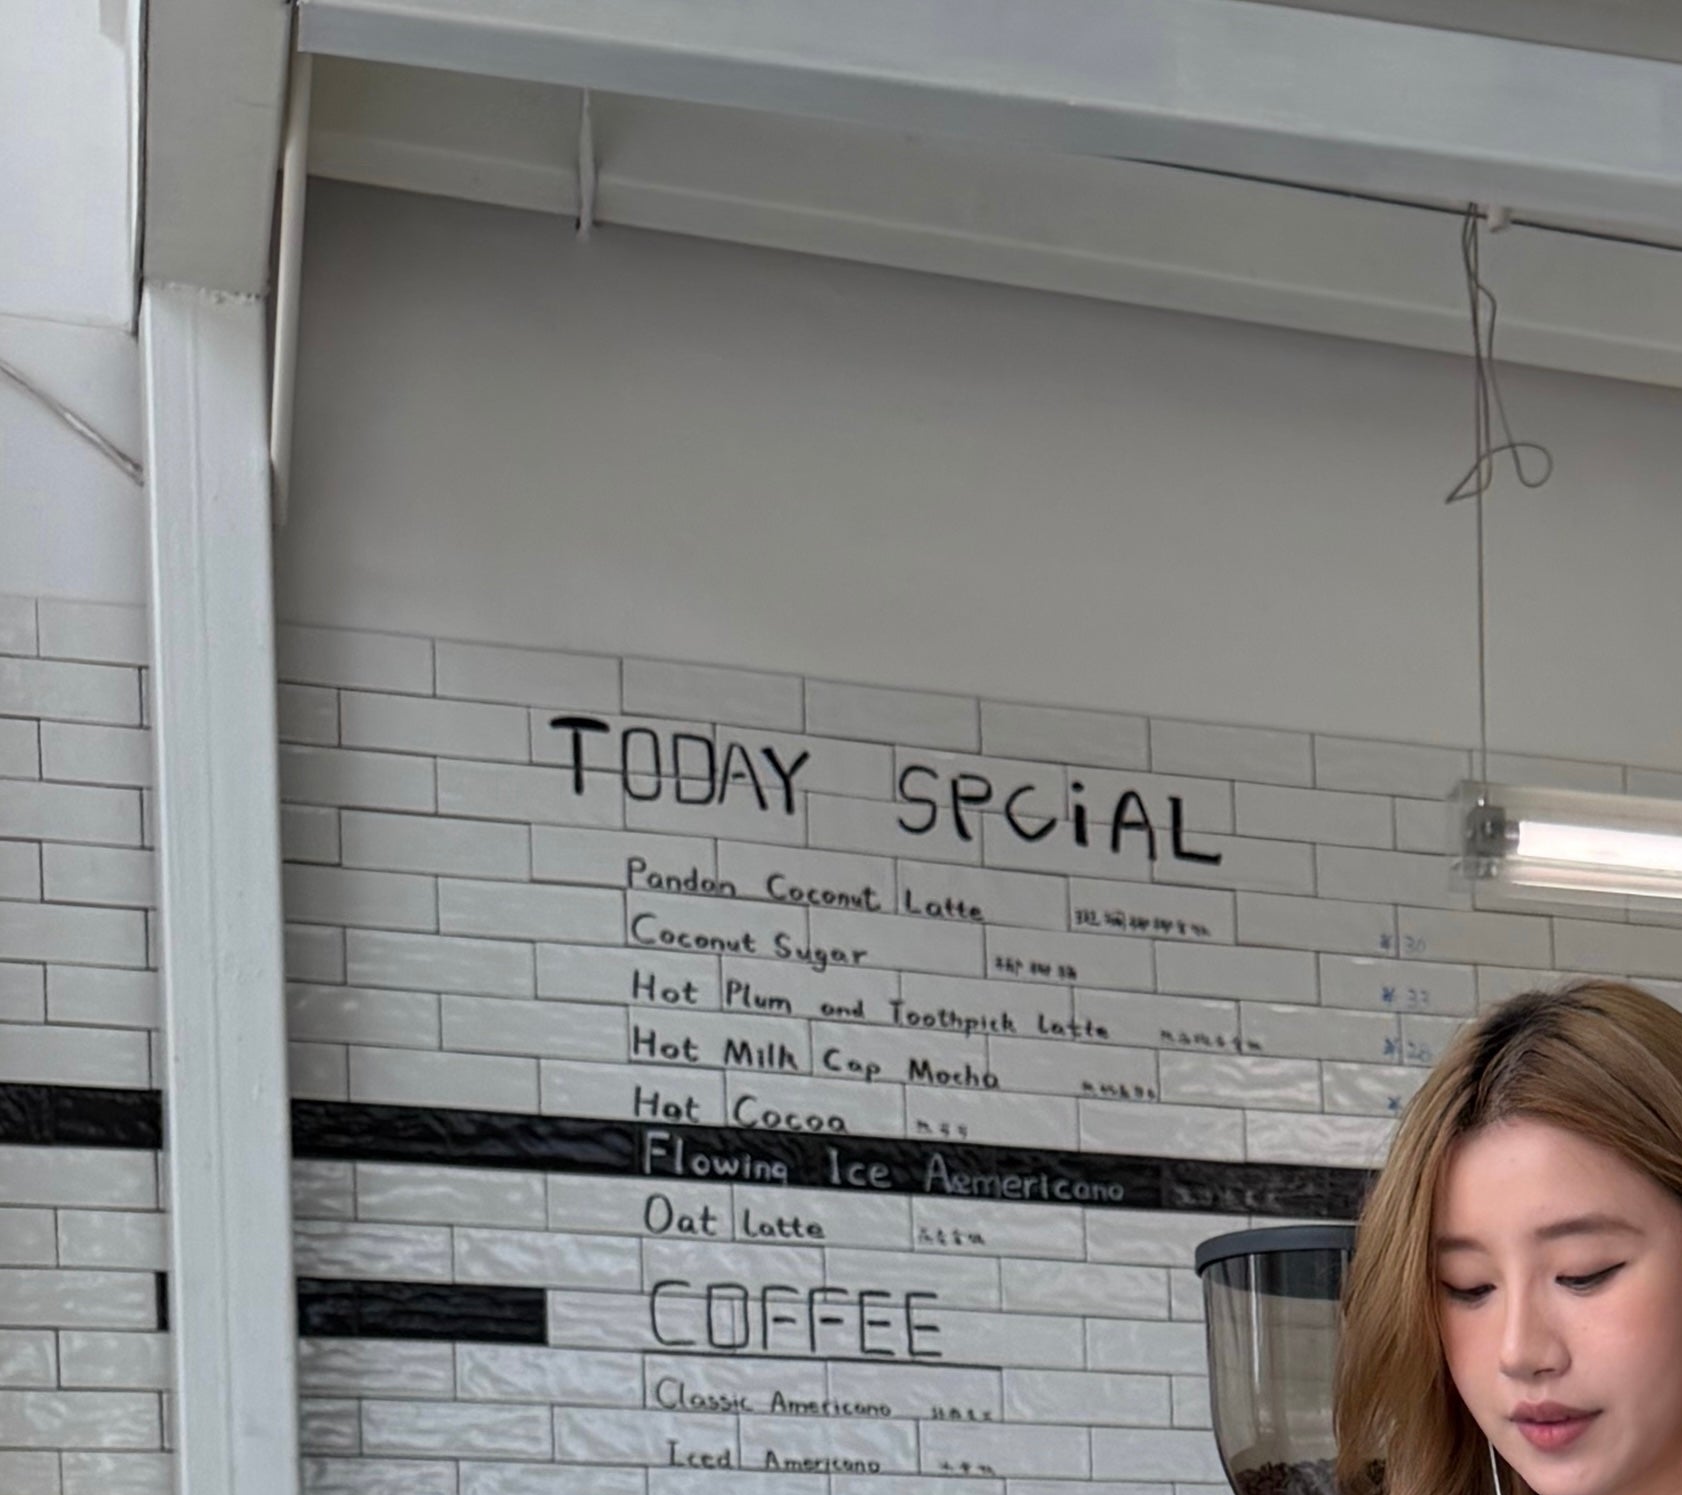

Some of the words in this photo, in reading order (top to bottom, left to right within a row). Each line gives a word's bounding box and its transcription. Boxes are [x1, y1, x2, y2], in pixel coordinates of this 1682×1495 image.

[550, 716, 810, 816] TODAY
[627, 856, 737, 898] Pandan
[767, 873, 881, 912] Coconut
[905, 888, 985, 922] Latte
[631, 912, 757, 953] Coconut
[774, 931, 868, 973] Sugar
[632, 969, 699, 1003] Hot
[726, 978, 792, 1014] Plum
[820, 1000, 865, 1019] and
[889, 1000, 1017, 1036] Toothpick
[632, 1025, 699, 1062] Hot
[724, 1038, 799, 1071] Milk
[823, 1048, 881, 1082] Cap
[908, 1055, 1000, 1091] Mocha
[633, 1086, 700, 1123] Hot
[733, 1094, 849, 1133] Cocoa
[644, 1131, 789, 1185] Flowing
[826, 1148, 892, 1189] Ice
[643, 1193, 717, 1236] Oat
[650, 1280, 943, 1357] COFFEE
[655, 1376, 754, 1410] Classic
[666, 1440, 731, 1470] Iced
